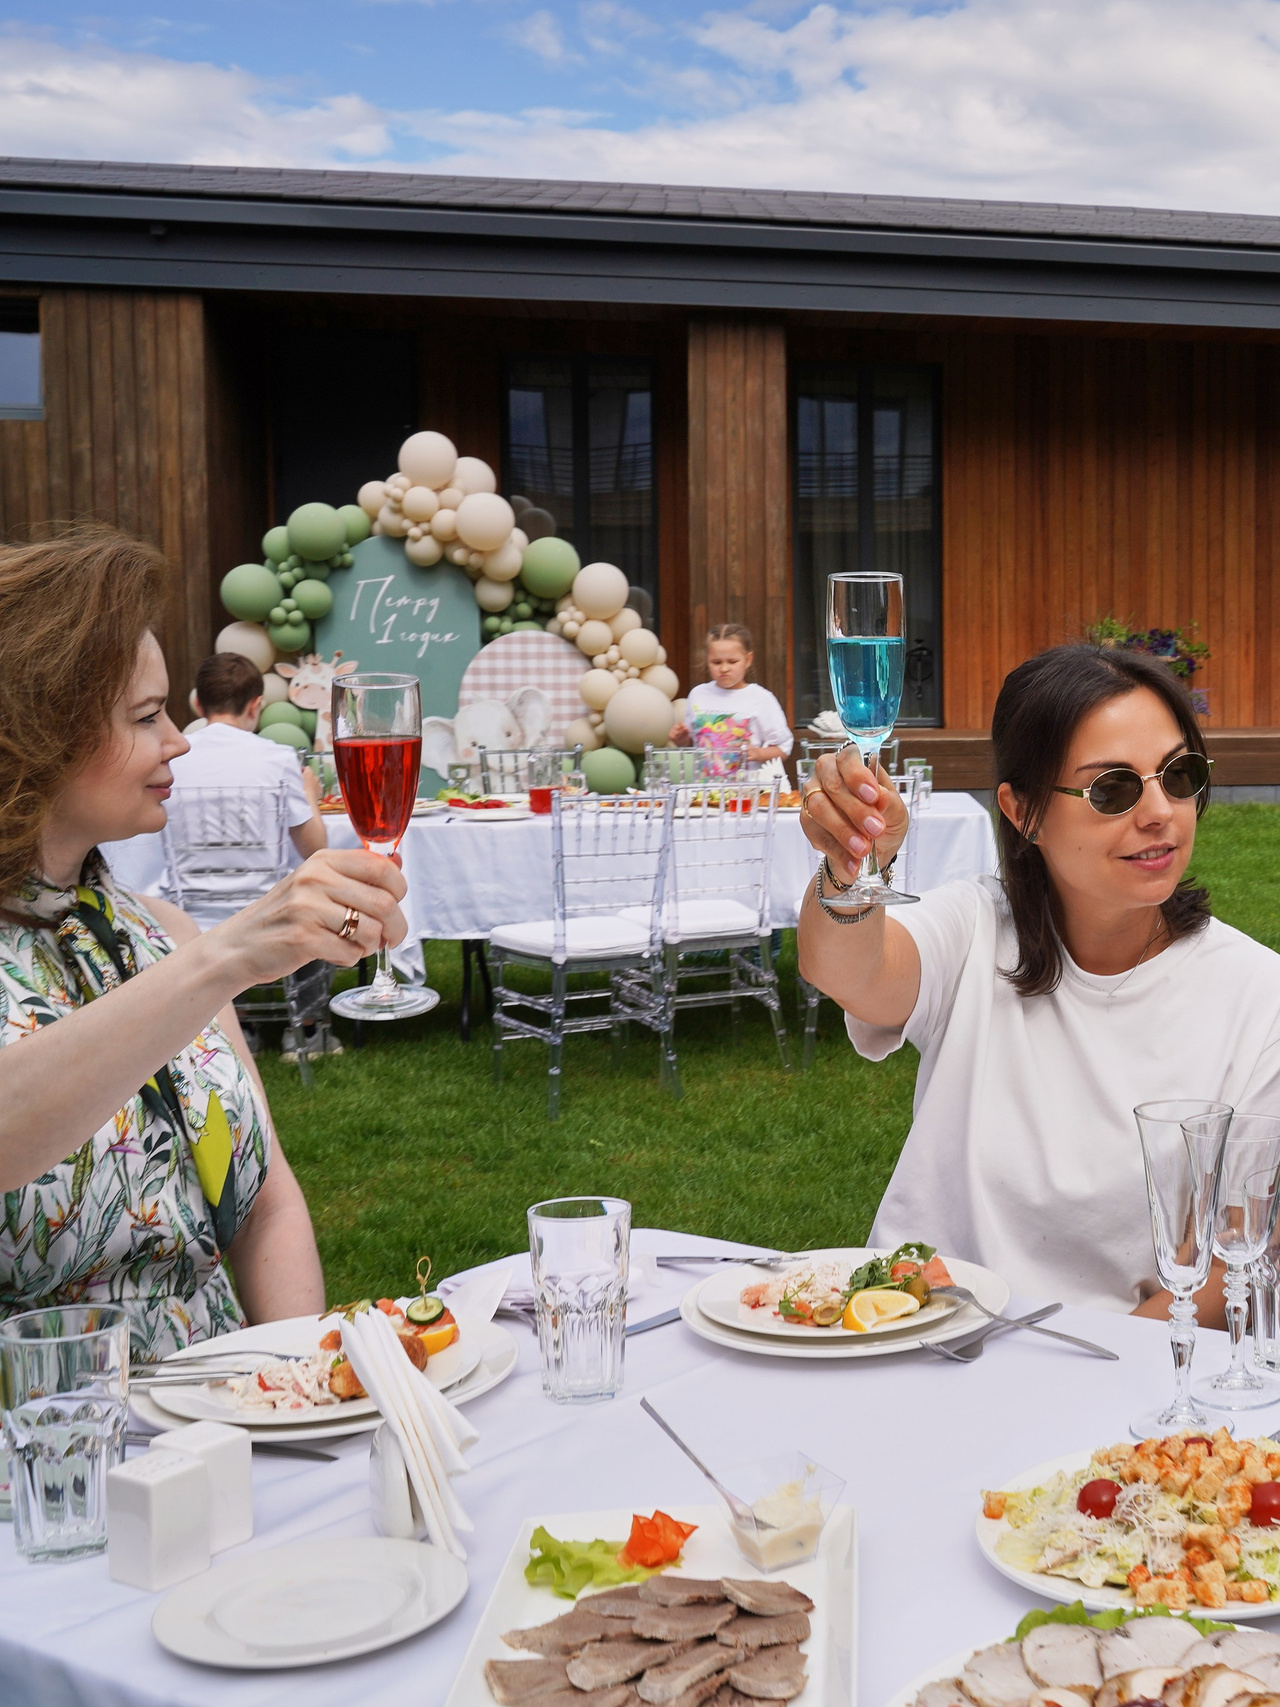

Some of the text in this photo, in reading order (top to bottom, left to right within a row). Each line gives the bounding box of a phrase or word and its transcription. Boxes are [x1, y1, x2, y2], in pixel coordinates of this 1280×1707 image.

[350, 574, 440, 633] Петру
[375, 613, 460, 658] 1 годик
